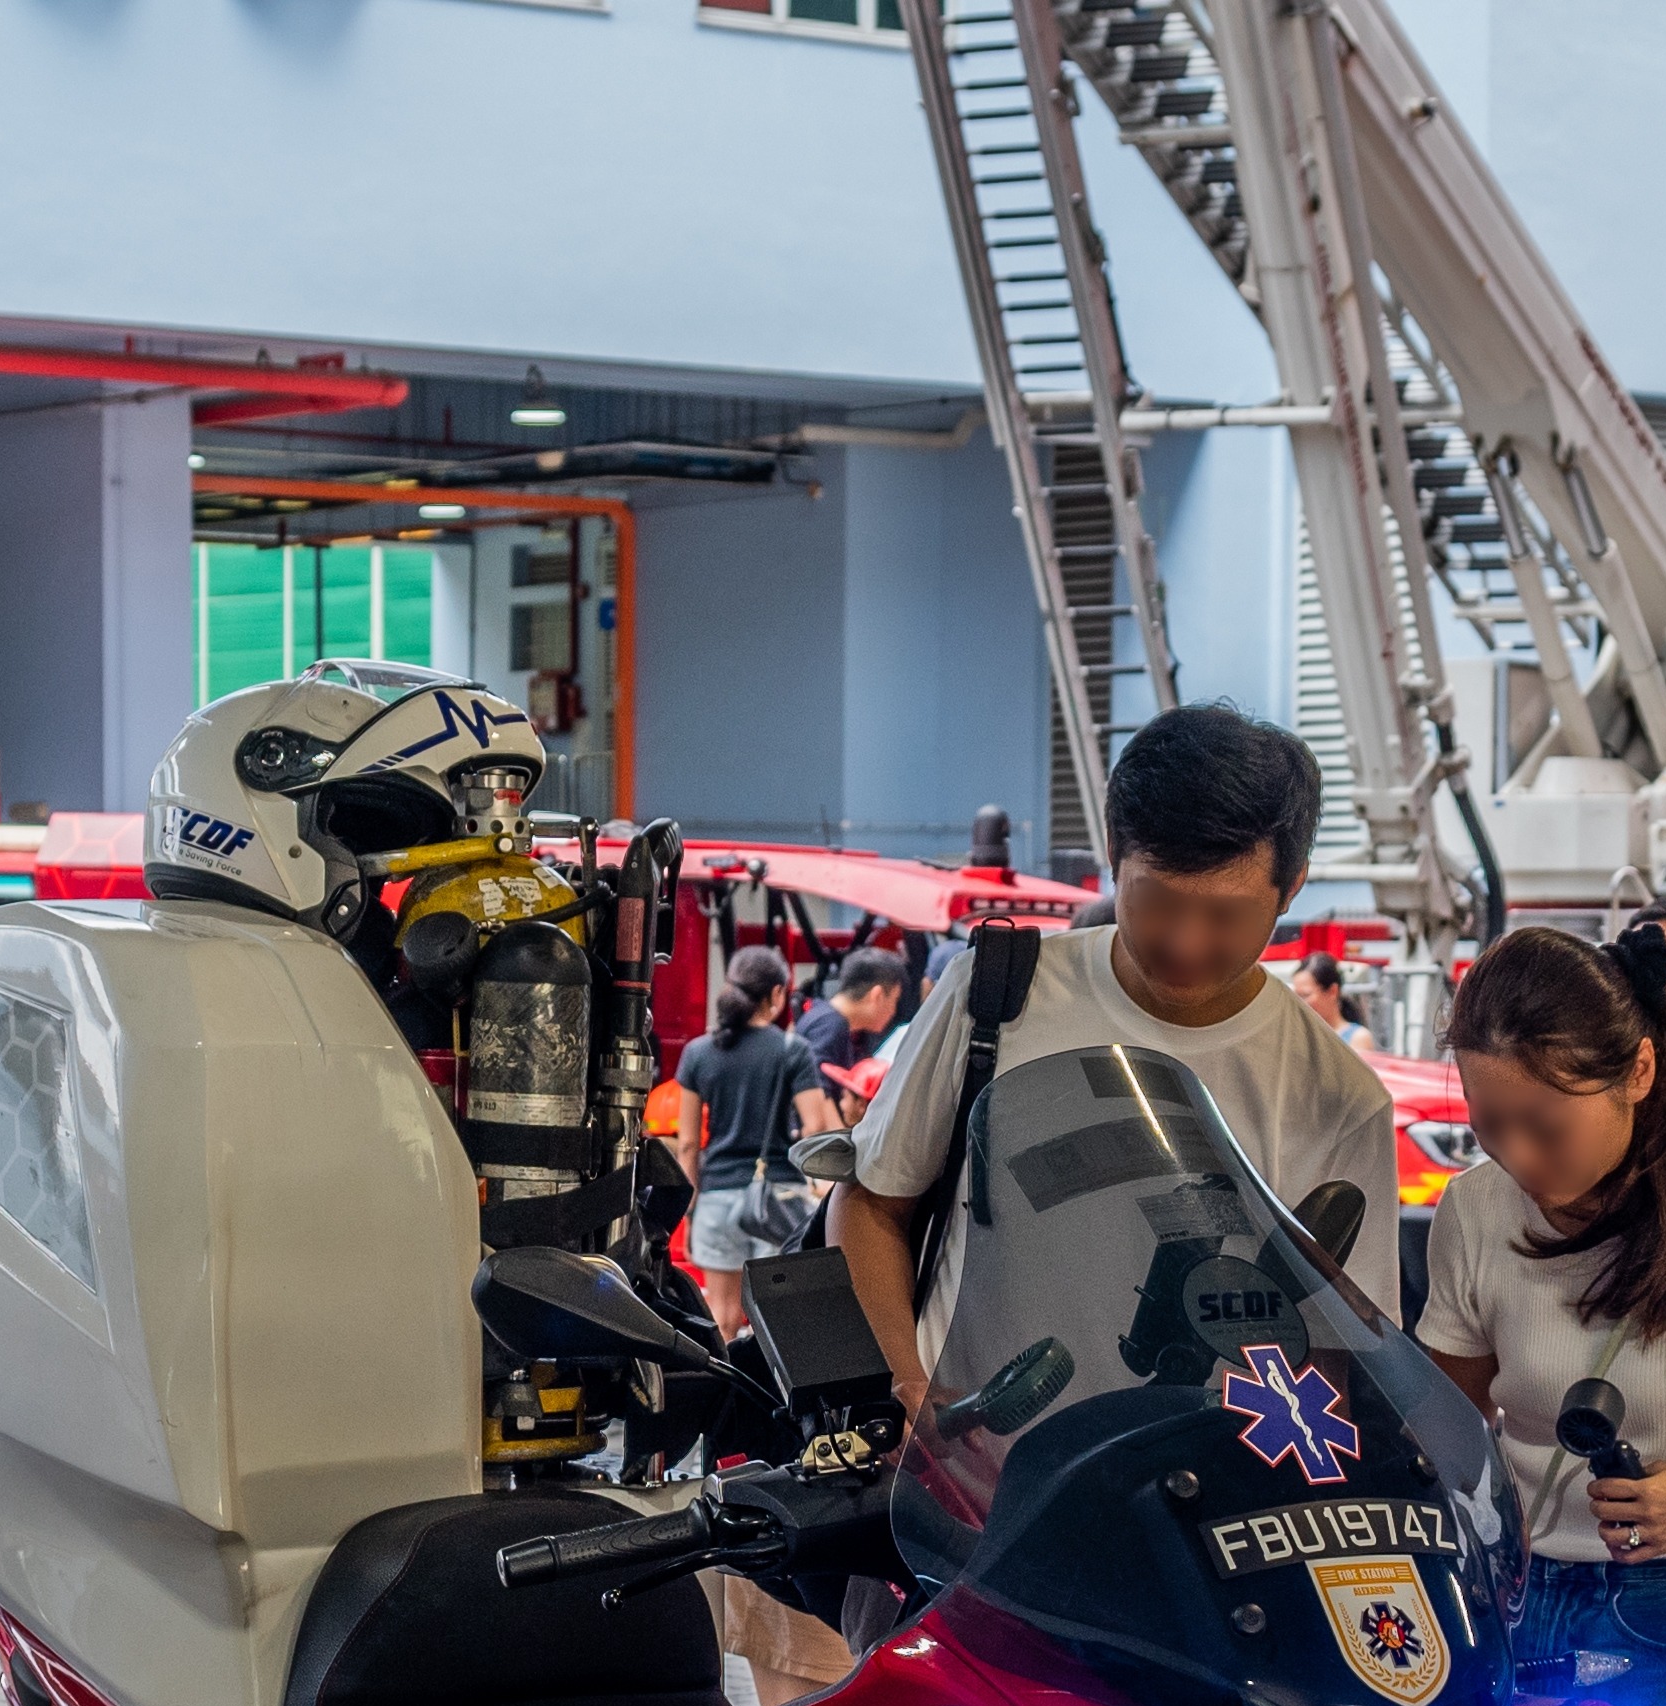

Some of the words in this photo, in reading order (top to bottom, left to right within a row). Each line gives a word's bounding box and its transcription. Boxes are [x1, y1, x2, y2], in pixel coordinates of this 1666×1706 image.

[185, 848, 214, 868] Saving
[216, 860, 243, 876] Force
[1198, 1290, 1284, 1323] SCDF
[1211, 1503, 1459, 1571] FBU1974Z
[1337, 1568, 1359, 1582] FIRE
[1360, 1566, 1397, 1581] STATION
